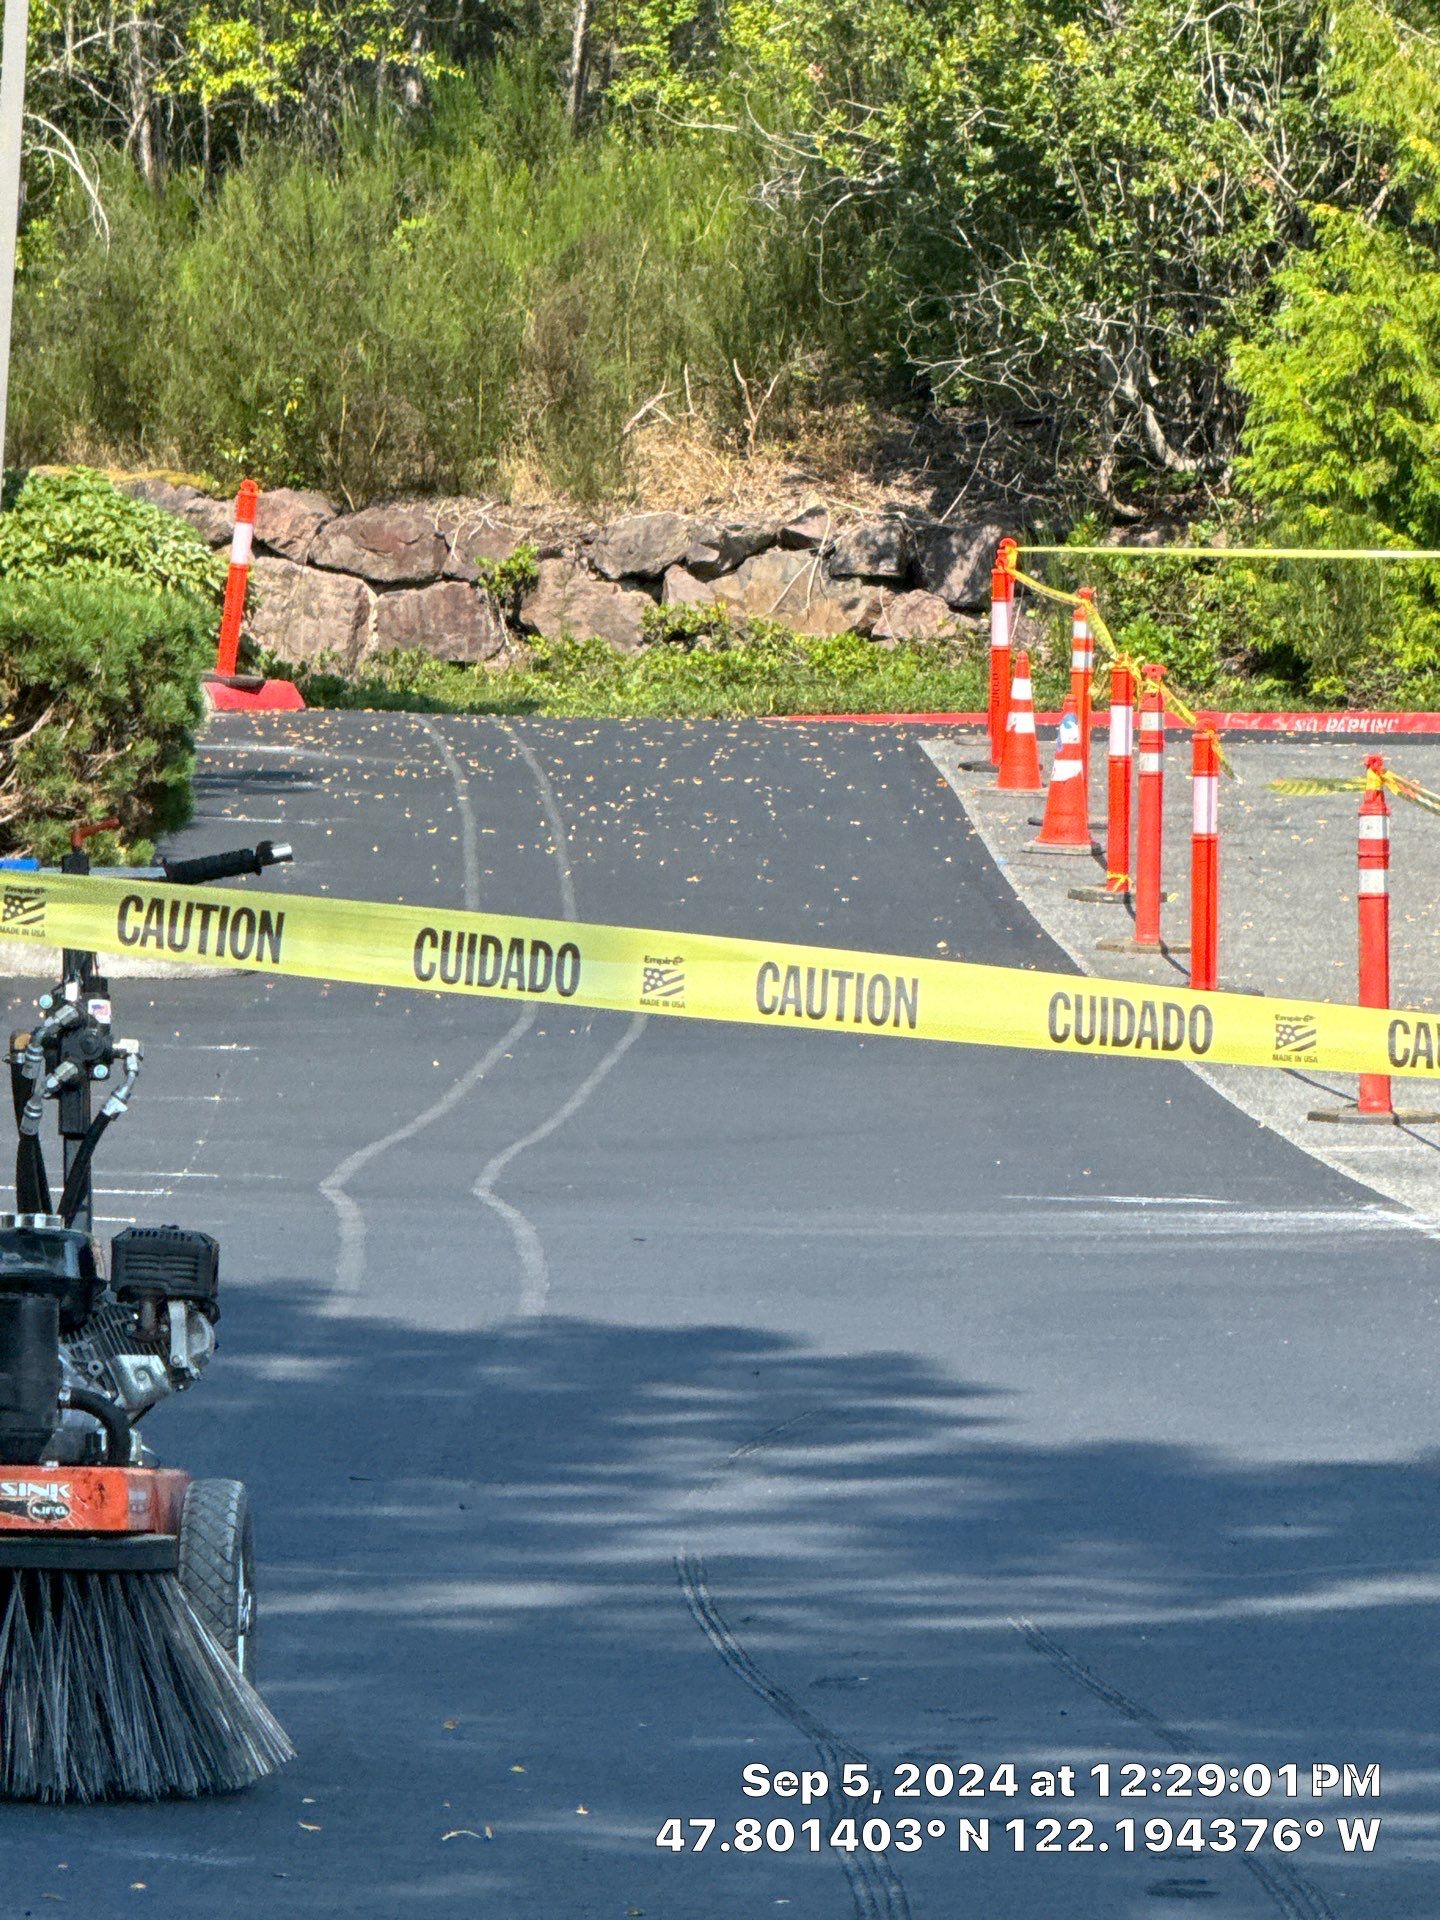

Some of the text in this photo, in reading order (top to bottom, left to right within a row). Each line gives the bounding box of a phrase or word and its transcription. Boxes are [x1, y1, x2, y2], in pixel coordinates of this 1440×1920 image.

[0, 926, 46, 937] MADE IN USA
[118, 893, 286, 965] CAUTION
[413, 927, 581, 998] CUIDADO
[639, 997, 686, 1009] MADE IN USA
[755, 961, 920, 1030] CAUTION
[1048, 991, 1213, 1057] CUIDADO
[1271, 1054, 1319, 1064] MADE IN USA
[1388, 1018, 1440, 1069] CA
